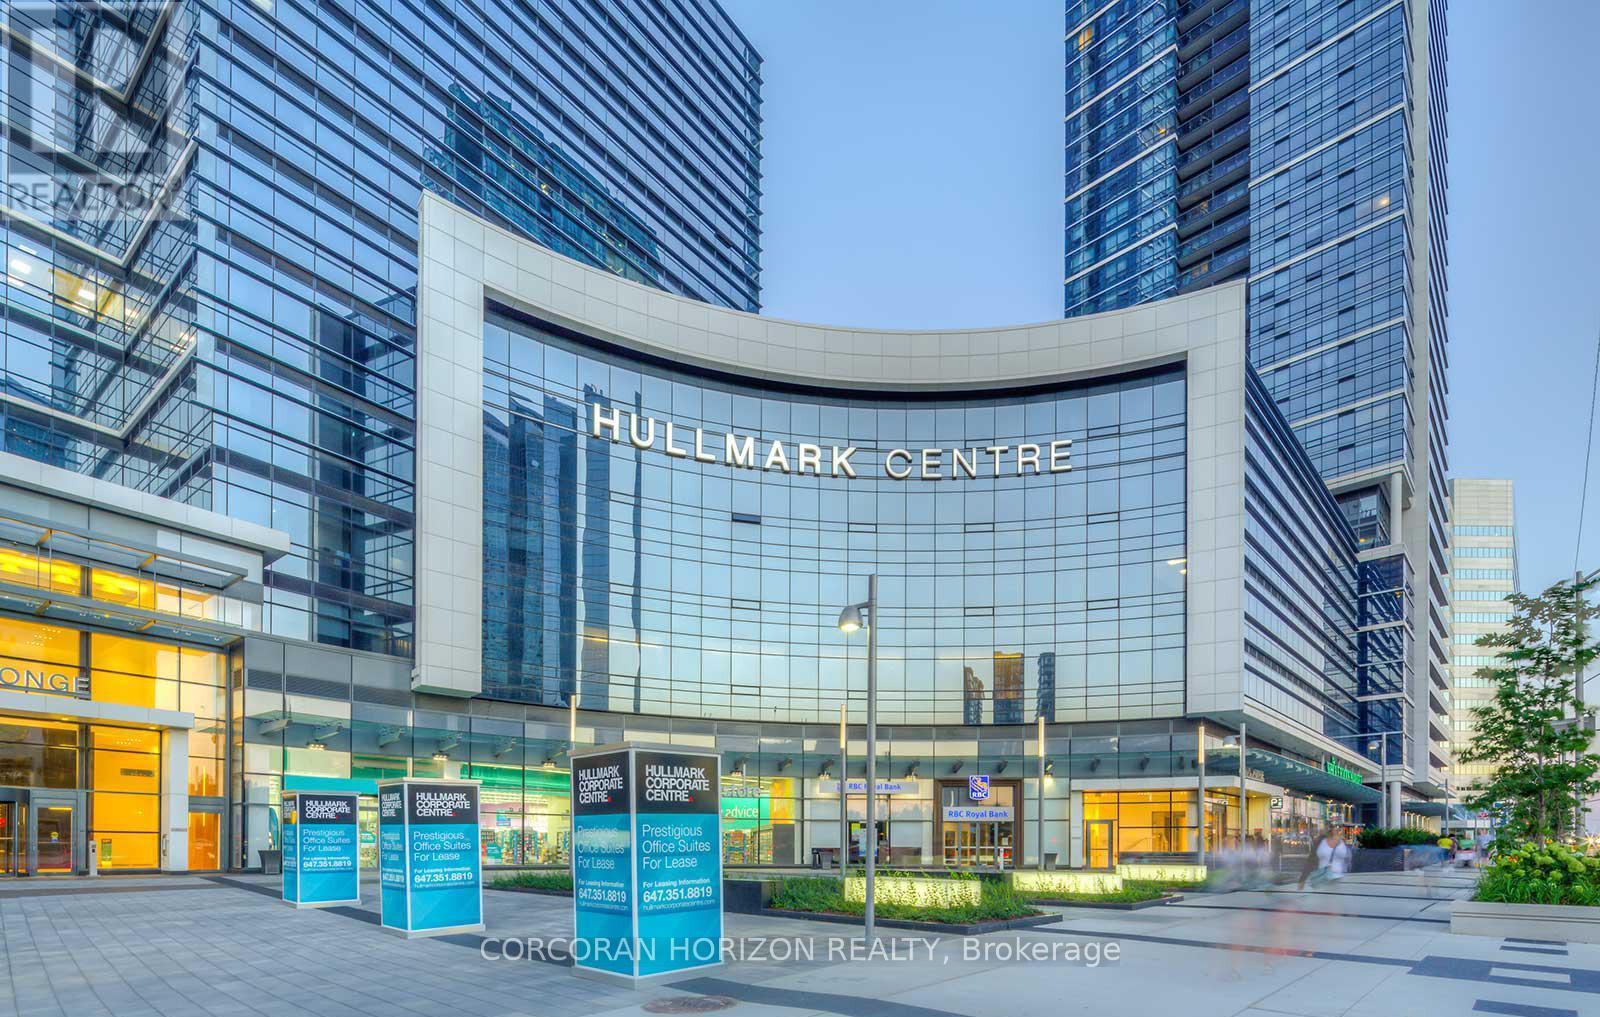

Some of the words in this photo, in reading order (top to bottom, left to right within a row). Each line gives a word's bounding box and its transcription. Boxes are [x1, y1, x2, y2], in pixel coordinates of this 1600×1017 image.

[593, 403, 857, 478] HULLMARK
[884, 439, 1074, 480] CENTRE
[578, 765, 620, 781] HULLMARK
[645, 764, 706, 779] HULLMARK
[578, 777, 624, 793] CORPORATE
[645, 777, 710, 791] CORPORATE
[416, 792, 467, 801] HULLMARK
[579, 791, 609, 804] CENTRE
[645, 788, 689, 802] CENTRE
[305, 800, 348, 808] HULLMARK
[305, 806, 352, 814] CORPORATE
[416, 800, 471, 809] CORPORATE
[416, 808, 453, 817] CENTRE
[725, 805, 759, 819] advice
[948, 810, 963, 818] RBC
[966, 810, 987, 819] Royal
[989, 810, 1009, 818] Bank
[303, 829, 345, 837] Prestigious
[413, 831, 465, 841] Prestigious
[642, 824, 703, 840] Prestigious
[327, 836, 351, 844] Suites
[413, 842, 441, 851] Office
[443, 841, 472, 850] Suites
[642, 840, 675, 854] Office
[678, 839, 711, 853] Suites
[303, 844, 316, 852] For
[414, 852, 430, 861] For
[433, 852, 461, 861] Lease
[578, 856, 591, 869] For
[592, 857, 615, 870] Lease
[643, 856, 662, 870] For
[665, 855, 698, 869] Lease
[414, 872, 473, 883] 647.351.8819
[578, 888, 627, 903] 647.351.8819
[643, 886, 713, 903] 647.351.8819
